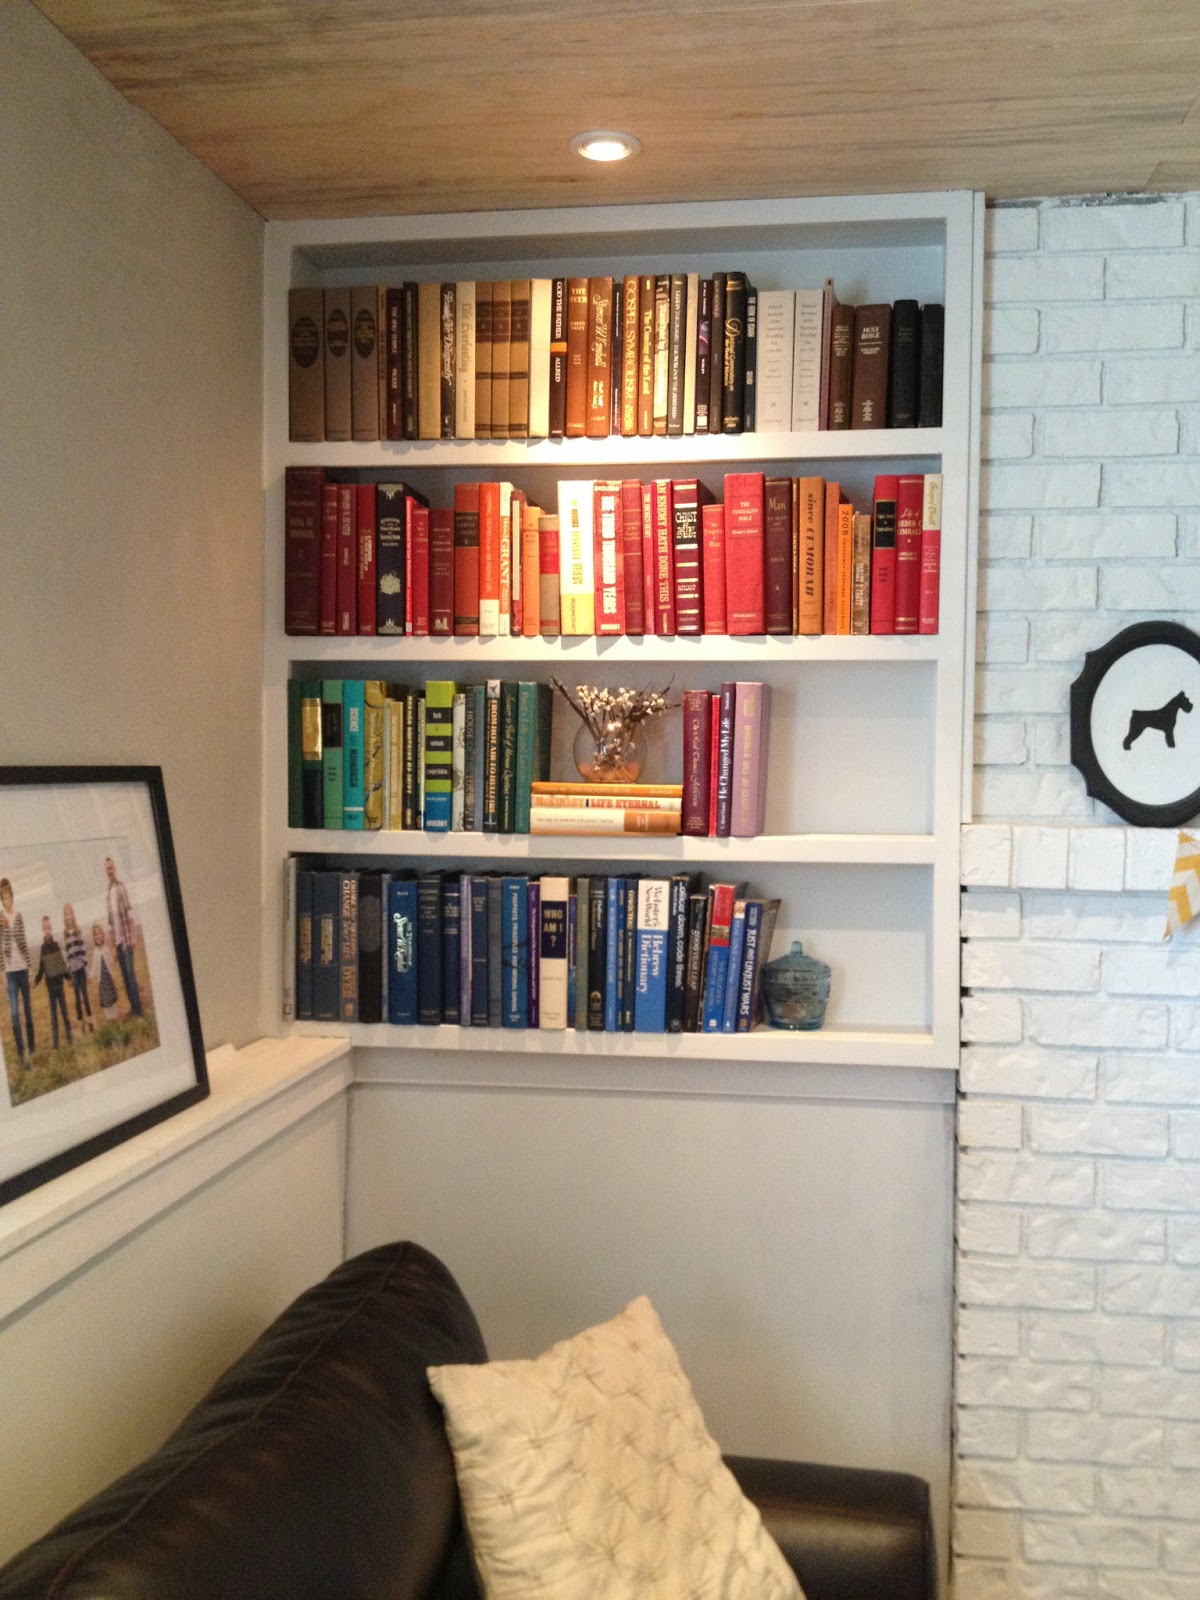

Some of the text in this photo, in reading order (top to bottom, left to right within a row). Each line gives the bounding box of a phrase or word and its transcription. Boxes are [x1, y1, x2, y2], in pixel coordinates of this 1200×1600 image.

[556, 281, 564, 299] GOD
[625, 280, 638, 328] GOSPEL
[643, 310, 653, 323] The
[554, 312, 563, 339] FATHER
[861, 332, 880, 340] BIBLE
[459, 323, 472, 373] Everlasting
[643, 325, 653, 354] Coming
[554, 357, 562, 382] ALLRED
[624, 330, 637, 399] SYMBOLISM
[643, 364, 651, 378] the
[642, 379, 652, 395] Lord
[601, 495, 615, 511] THE
[675, 511, 697, 523] CHRIST
[841, 510, 849, 536] 2008
[656, 481, 670, 603] AN ENEMY HATH DONE THIS
[805, 493, 818, 597] since CUMORAH
[501, 538, 511, 586] GRANT
[603, 586, 617, 614] YEARS
[855, 589, 864, 606] PRATT
[466, 711, 475, 738] HOUSE
[743, 724, 753, 758] KINGDOM
[489, 700, 498, 814] FROM HOT AIR TO HELLFIRE
[718, 717, 733, 800] He Changed My Life
[742, 760, 752, 775] THE
[590, 800, 613, 808] LIFE
[615, 800, 661, 809] ETERNAL
[688, 775, 701, 808] Jefferson
[342, 879, 351, 918] CHANGE
[643, 886, 654, 928] New World
[652, 886, 664, 928] Webster's
[543, 909, 564, 919] WHO
[543, 922, 557, 933] AM
[342, 941, 351, 960] LIFE
[732, 920, 741, 955] REAL LOVE
[746, 929, 758, 947] JUST
[635, 934, 652, 994] Dictionary
[651, 934, 664, 977] Hebrew
[676, 943, 685, 963] code
[690, 929, 701, 990] 5000 YEAR LEAP
[747, 947, 755, 960] AND
[342, 965, 352, 999] DYER
[741, 961, 754, 991] UNJUST
[707, 986, 717, 1013] AMERICA
[739, 991, 751, 1015] WARS
